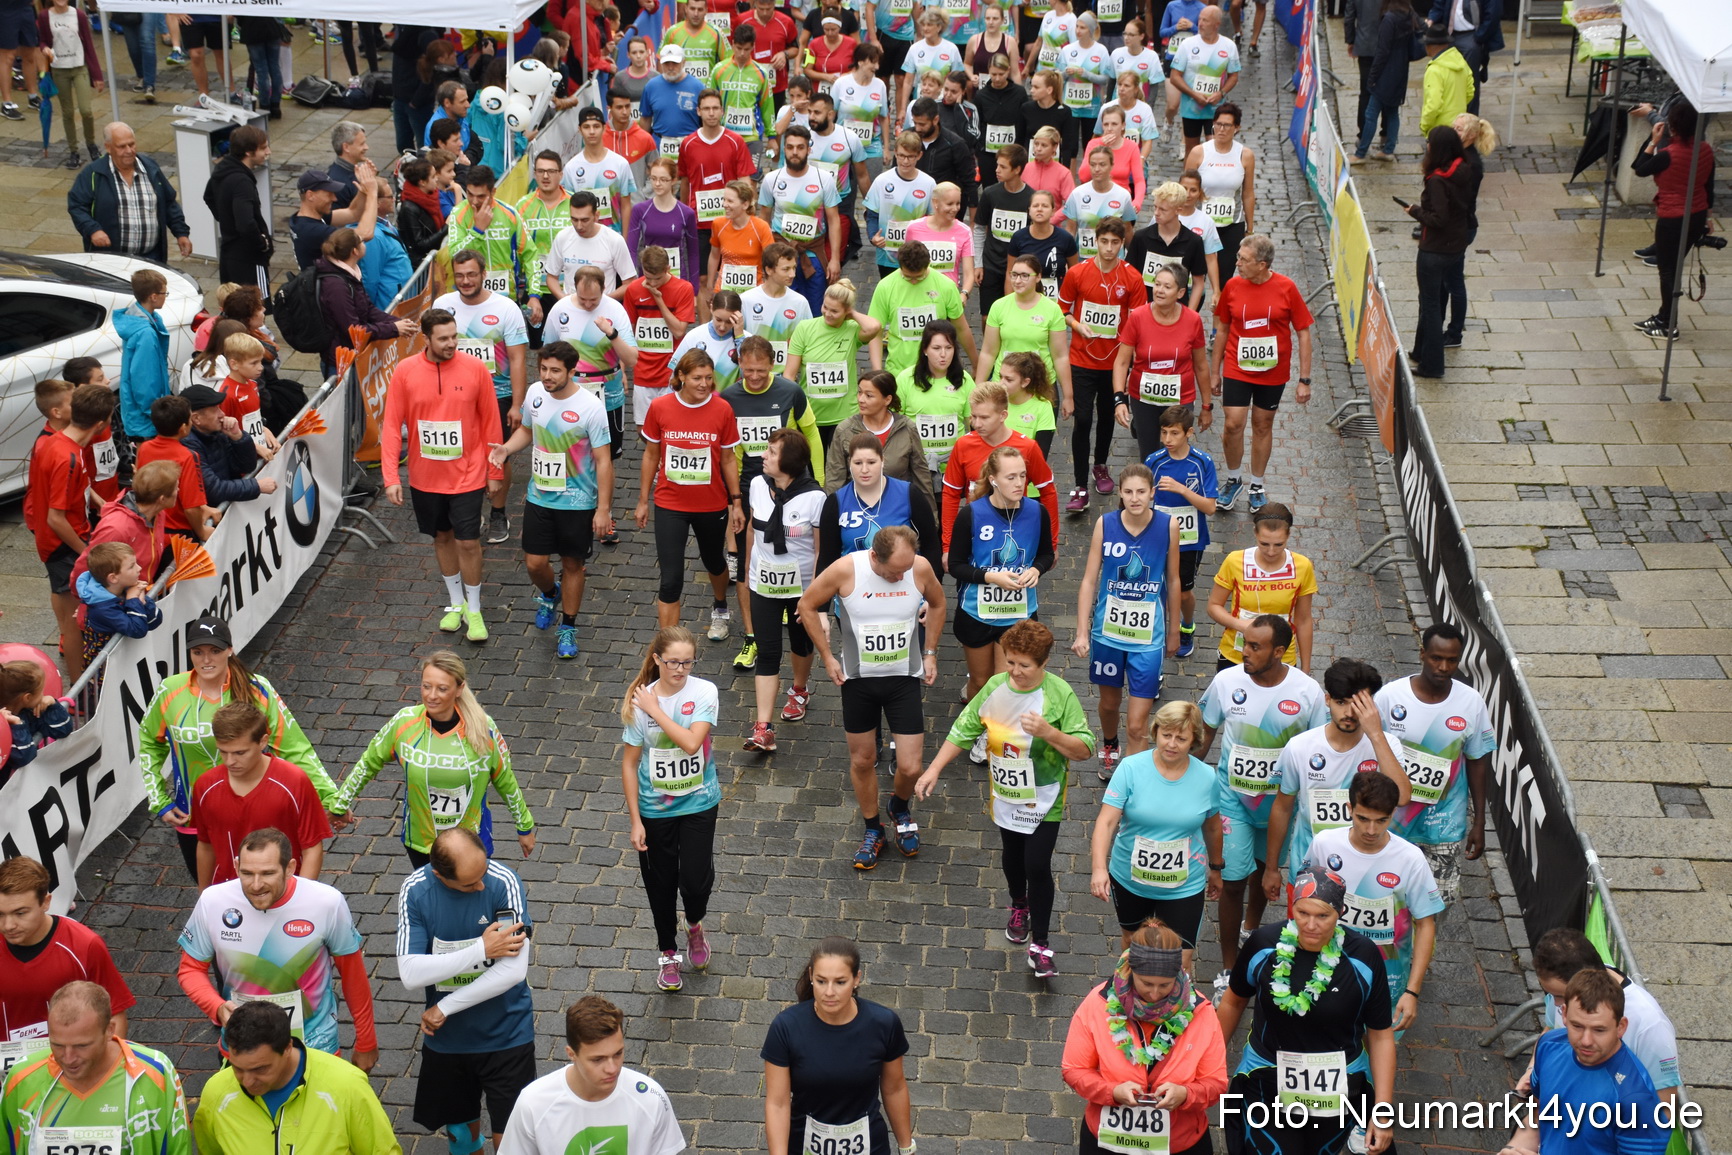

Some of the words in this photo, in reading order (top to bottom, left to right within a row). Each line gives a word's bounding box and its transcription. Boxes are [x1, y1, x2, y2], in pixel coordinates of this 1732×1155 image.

[1100, 3, 1121, 14] 5162
[1068, 87, 1091, 99] 5185
[1196, 81, 1219, 93] 5186
[728, 113, 750, 125] 2870
[989, 131, 1015, 144] 5176
[1205, 204, 1232, 216] 5104
[785, 221, 814, 236] 5202
[995, 217, 1023, 231] 5191
[484, 278, 506, 291] 869
[725, 272, 754, 286] 5090
[1084, 308, 1117, 327] 5002
[638, 325, 670, 339] 5166
[1241, 345, 1275, 360] 5084
[811, 369, 845, 386] 5144
[1144, 381, 1178, 398] 5085
[664, 430, 710, 442] NEUMARKT
[920, 420, 955, 438] 5119
[421, 429, 459, 447] 5116
[926, 440, 950, 449] Larissa
[430, 447, 451, 457] Daniel
[533, 457, 562, 477] 5117
[669, 455, 707, 472] 5047
[680, 472, 697, 481] Anita
[839, 511, 864, 529] 45
[979, 524, 994, 541] 8
[1102, 541, 1127, 558] 10
[760, 569, 796, 586] 5077
[768, 586, 790, 595] Christa
[875, 590, 910, 598] KLEBL
[983, 584, 1023, 603] 5028
[1243, 584, 1267, 592] MAX
[1270, 582, 1298, 592] BÖGL
[988, 604, 1017, 614] Christina
[1109, 606, 1150, 629] 5138
[1117, 627, 1137, 638] Luisa
[864, 631, 907, 653] 5015
[873, 653, 898, 662] Roland
[1093, 660, 1119, 678] 10
[655, 756, 701, 780] 5105
[991, 764, 1029, 787] 5251
[998, 788, 1021, 799] Christa
[429, 793, 461, 814] 271
[1137, 849, 1185, 870] 5224
[1142, 871, 1178, 882] Elisabeth
[1339, 903, 1389, 929] 2734
[286, 922, 315, 935] Hervis
[1363, 929, 1396, 940] Ibrahim
[19, 1027, 39, 1039] DEHN
[1285, 1066, 1341, 1092] 5147
[1107, 1105, 1165, 1134] 5048
[810, 1132, 865, 1155] 5033
[1115, 1135, 1150, 1148] Monika
